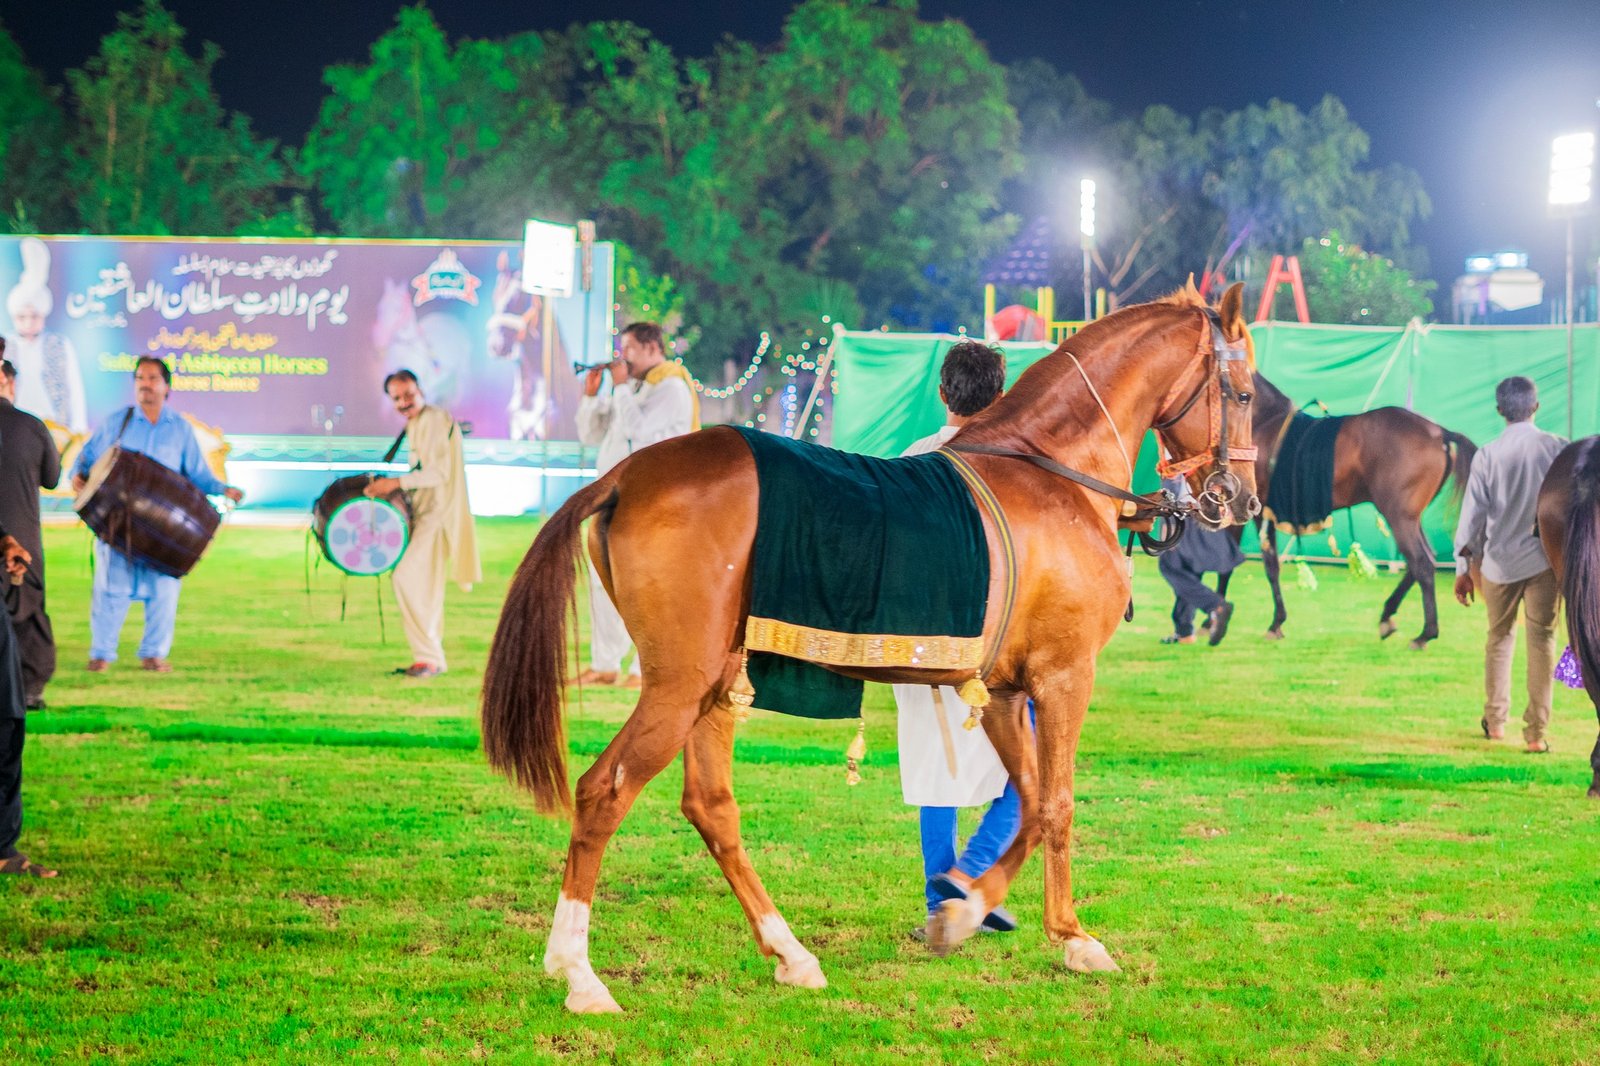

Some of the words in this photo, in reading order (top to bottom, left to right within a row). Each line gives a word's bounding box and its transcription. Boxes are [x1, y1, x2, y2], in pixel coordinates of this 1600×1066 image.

[160, 276, 236, 320] سلطان
[307, 285, 349, 332] یوم
[264, 353, 328, 375] Horses
